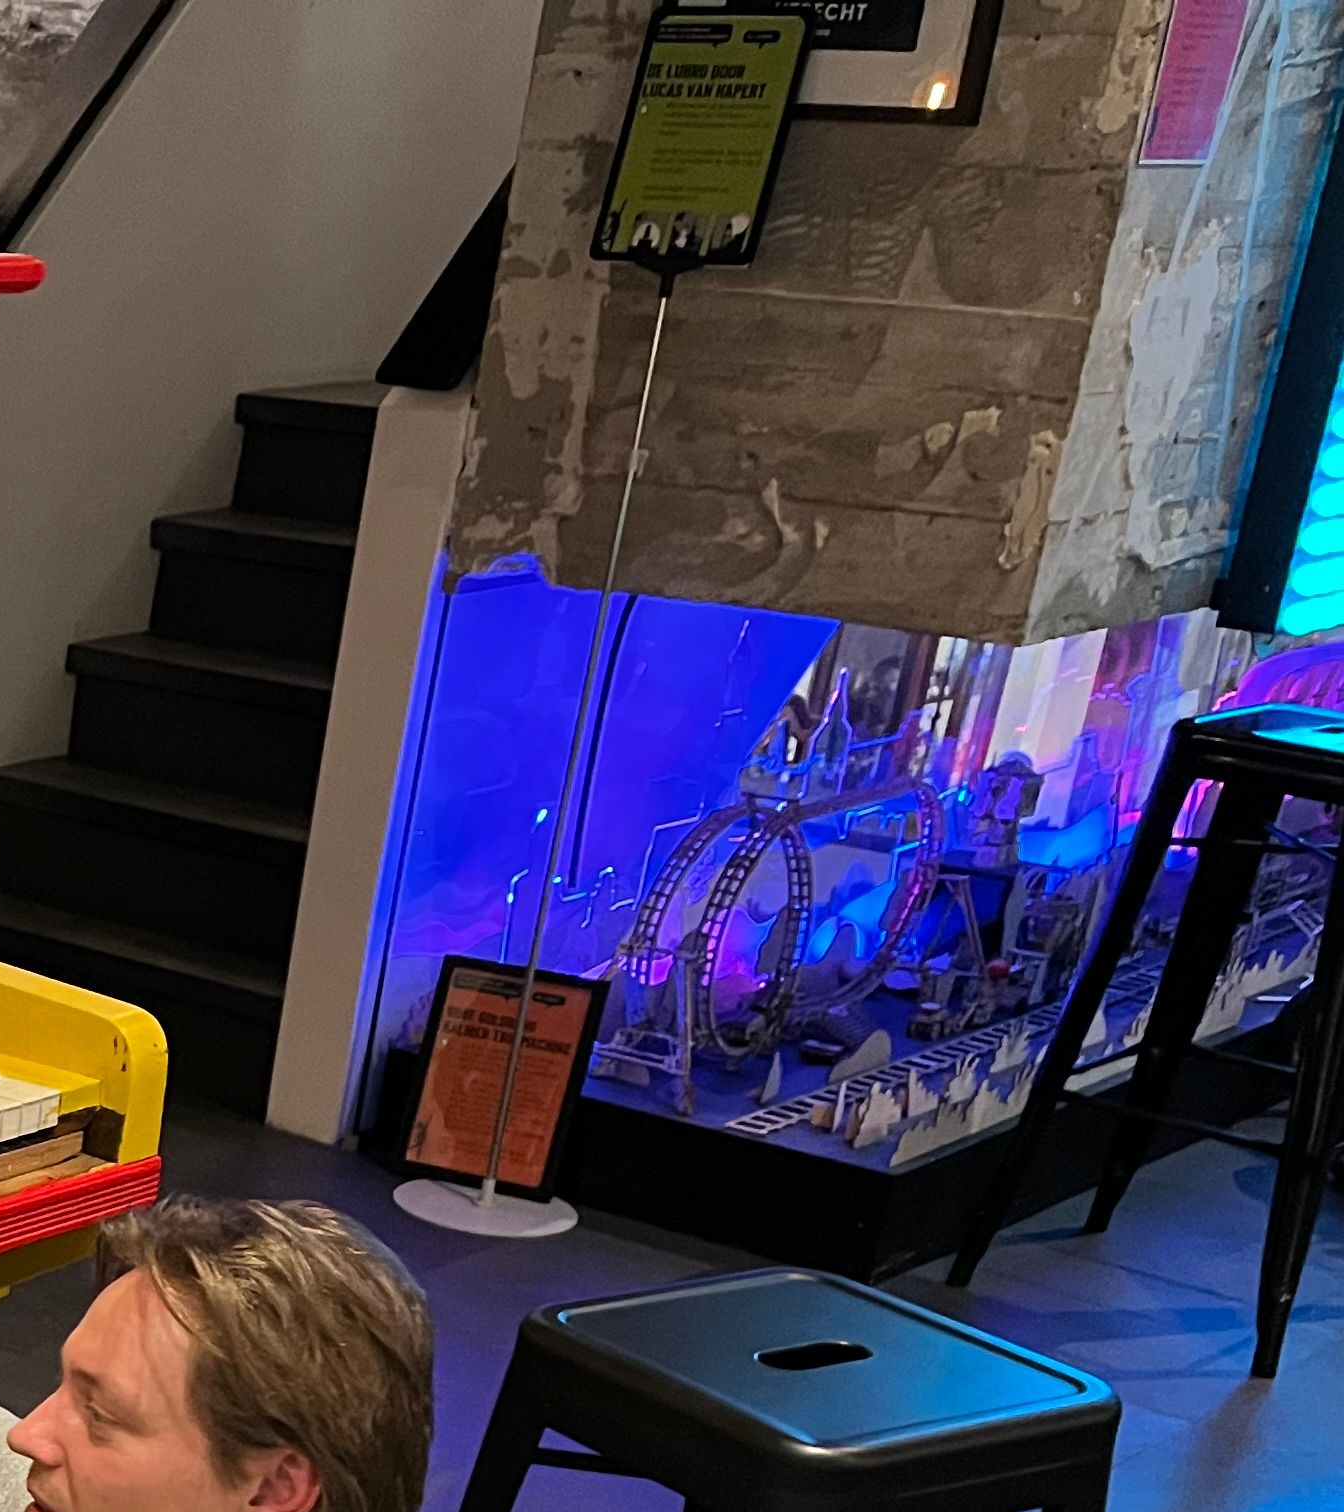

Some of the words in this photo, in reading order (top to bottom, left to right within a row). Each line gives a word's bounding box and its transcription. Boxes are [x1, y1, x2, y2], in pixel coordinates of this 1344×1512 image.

[775, 2, 868, 21] ECHT
[643, 82, 684, 98] LUCAS
[687, 82, 714, 98] VAN
